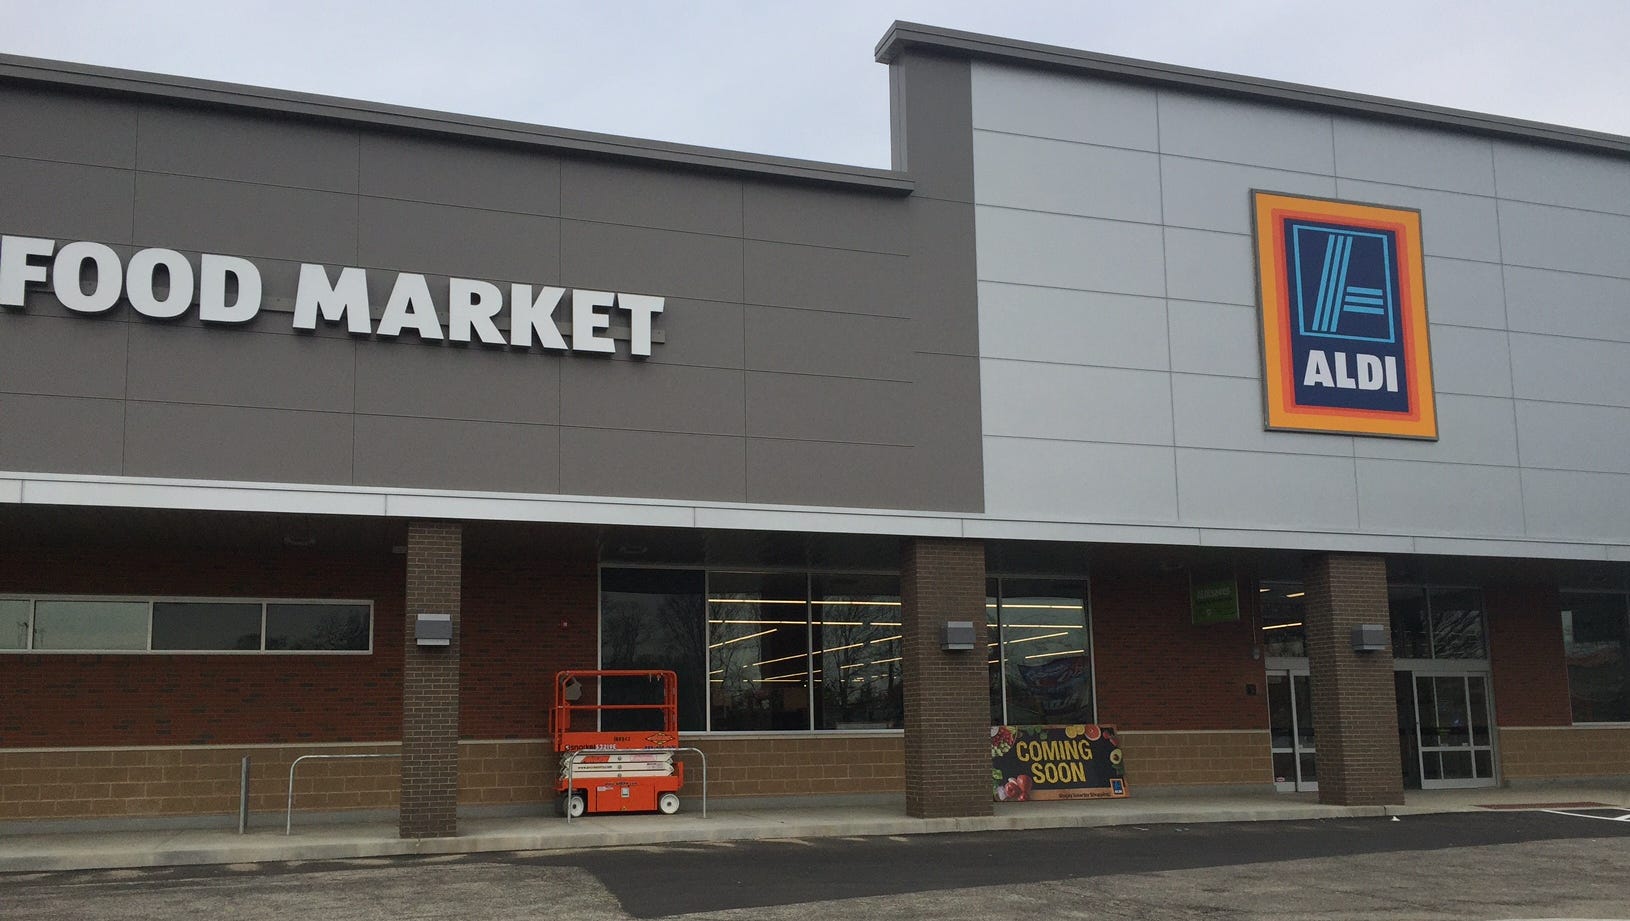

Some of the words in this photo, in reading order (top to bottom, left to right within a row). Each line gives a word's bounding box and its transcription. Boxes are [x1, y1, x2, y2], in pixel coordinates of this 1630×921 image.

[0, 235, 263, 322] FOOD
[293, 263, 666, 357] MARKET
[1303, 349, 1398, 393] ALDI
[1016, 740, 1093, 762] COMING
[1031, 762, 1087, 784] SOON
